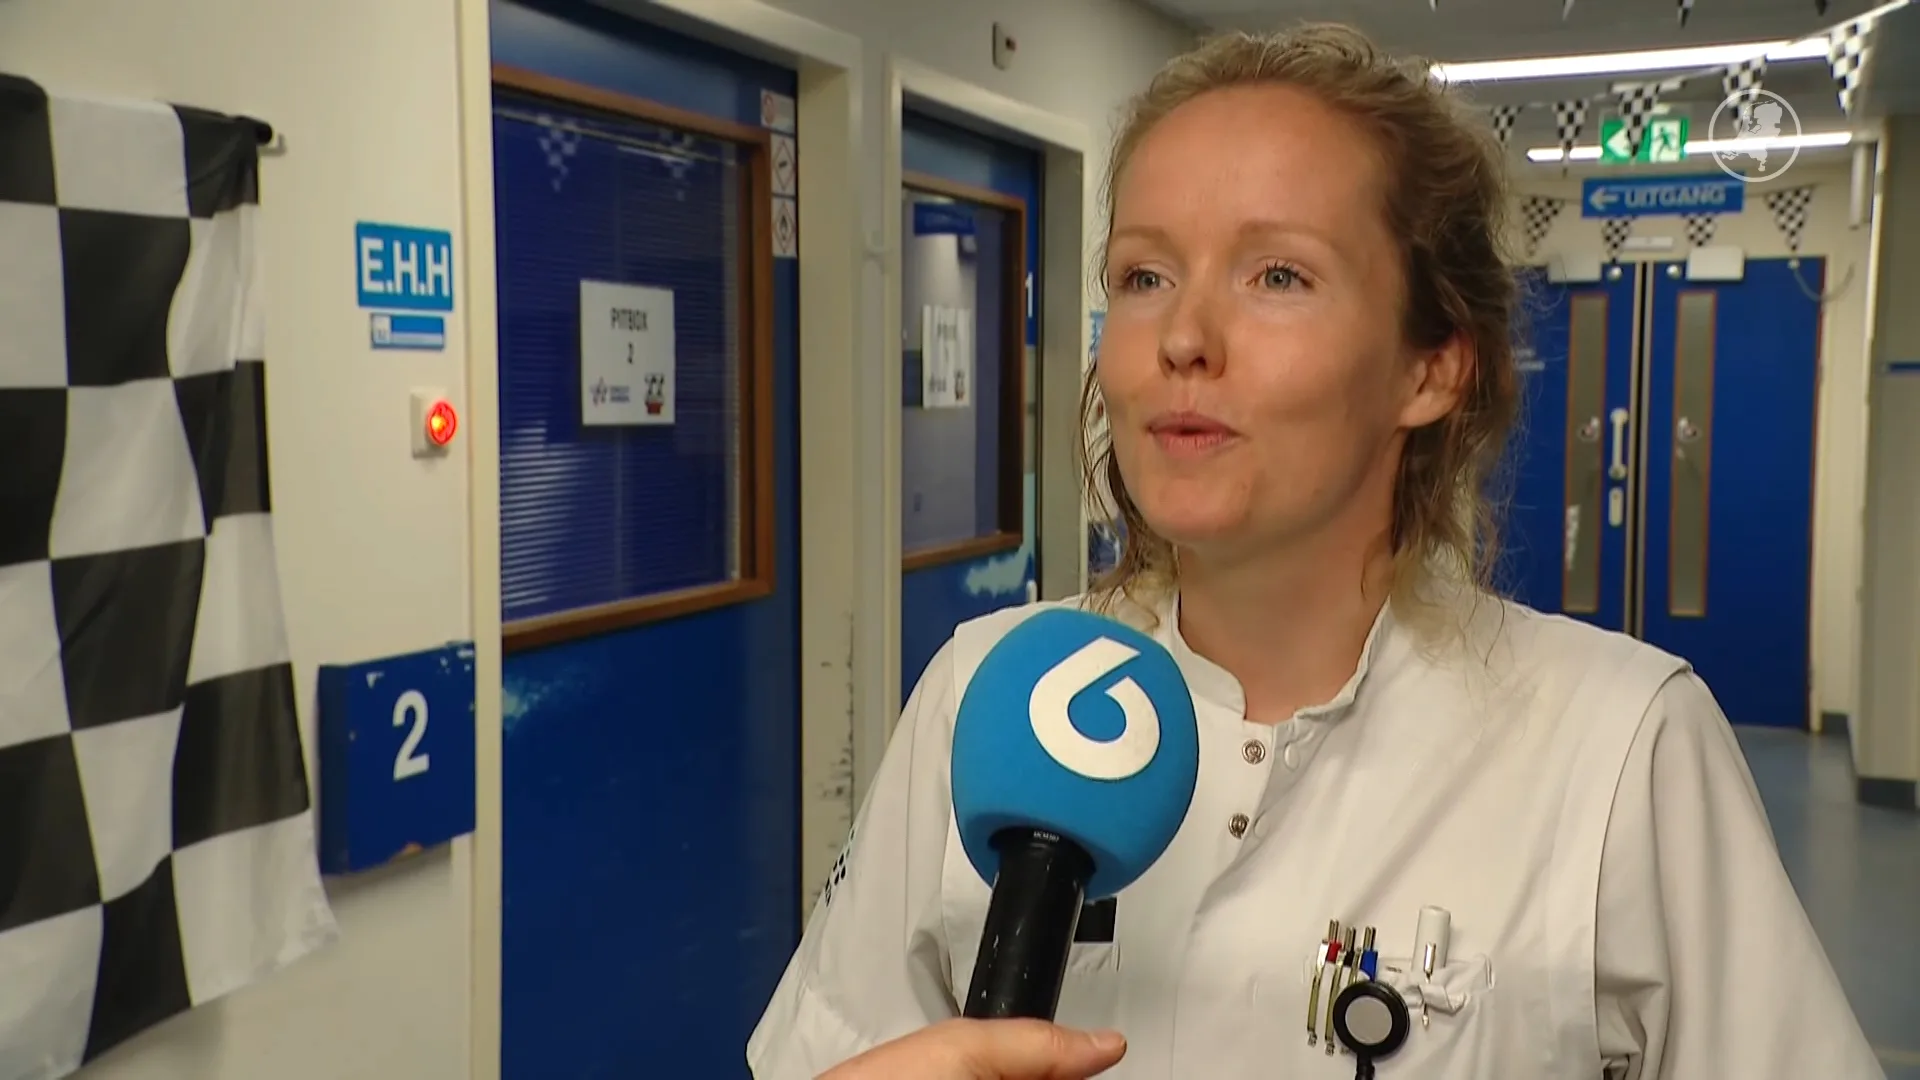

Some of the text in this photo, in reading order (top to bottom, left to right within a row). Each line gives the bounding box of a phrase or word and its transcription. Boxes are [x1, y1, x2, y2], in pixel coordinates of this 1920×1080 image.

[1624, 182, 1727, 209] UITGANG
[361, 236, 451, 298] E.H.H
[392, 688, 430, 782] 2
[1029, 635, 1162, 780] 6
